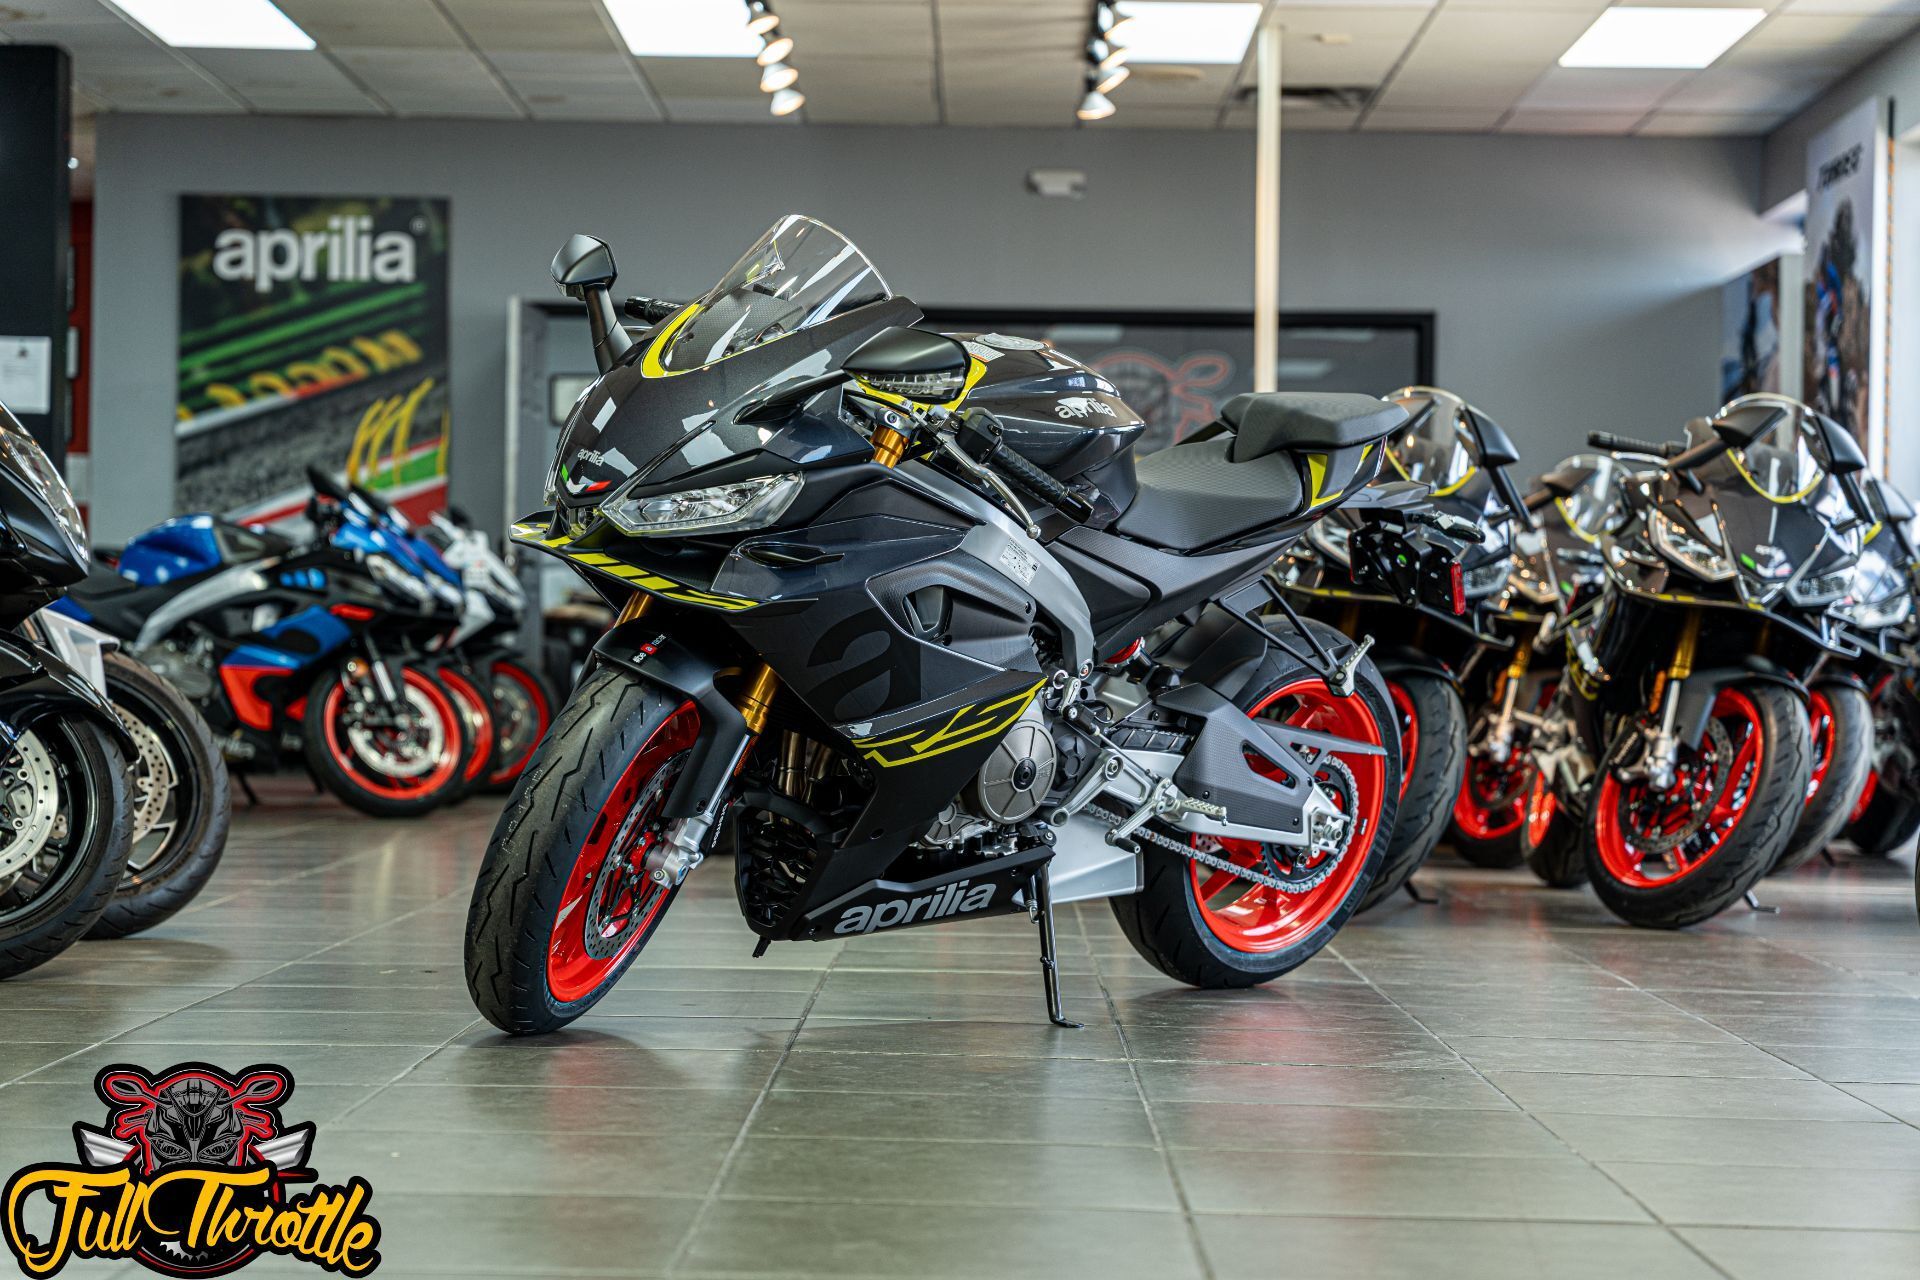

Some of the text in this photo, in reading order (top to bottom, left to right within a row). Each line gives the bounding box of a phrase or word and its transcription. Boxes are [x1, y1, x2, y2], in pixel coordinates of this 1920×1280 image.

[213, 215, 416, 292] aprilia
[1055, 397, 1117, 418] aprilia
[577, 448, 605, 467] aprilia
[834, 880, 997, 934] aprilia
